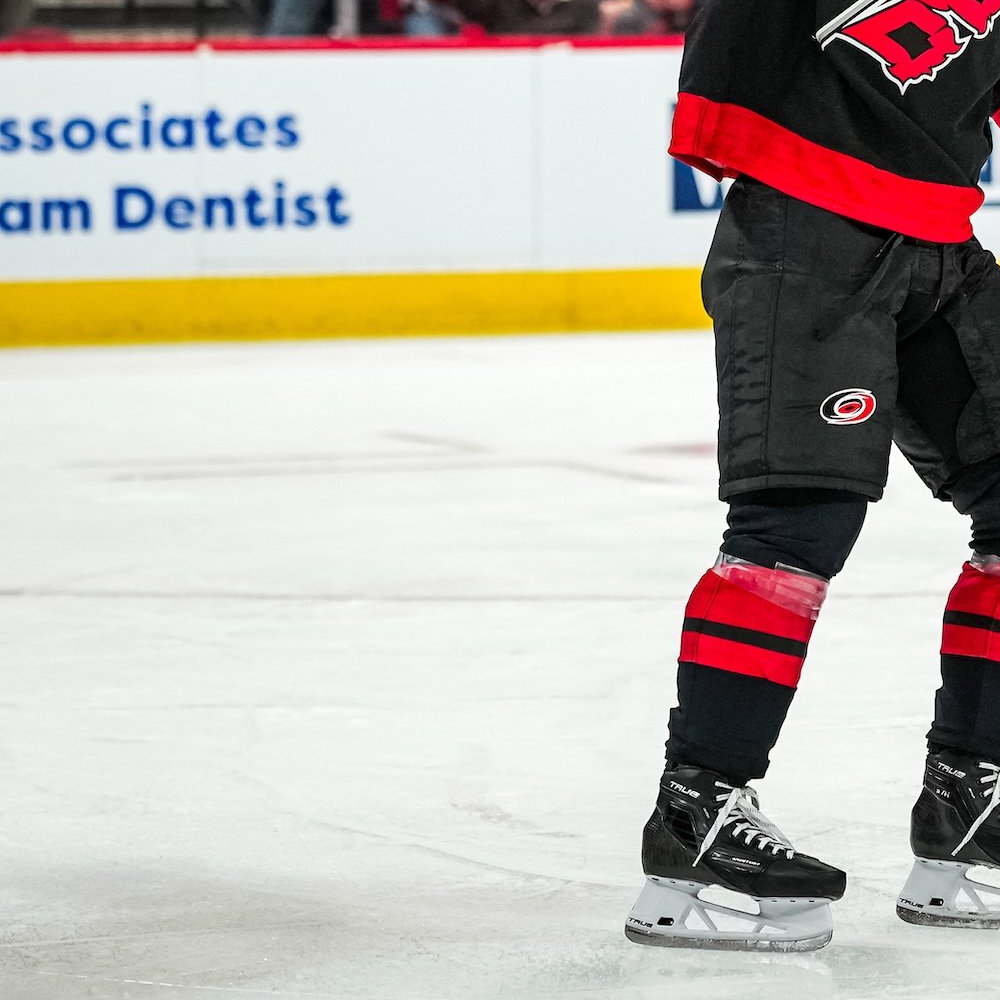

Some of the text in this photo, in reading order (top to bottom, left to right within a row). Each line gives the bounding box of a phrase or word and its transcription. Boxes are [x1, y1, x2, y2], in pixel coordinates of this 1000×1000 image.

[0, 102, 299, 151] ssociates
[0, 181, 349, 232] am Dentist
[938, 762, 966, 779] TRUE
[670, 780, 700, 799] TRUE
[899, 897, 924, 909] TRUE
[629, 916, 653, 928] TRUE
